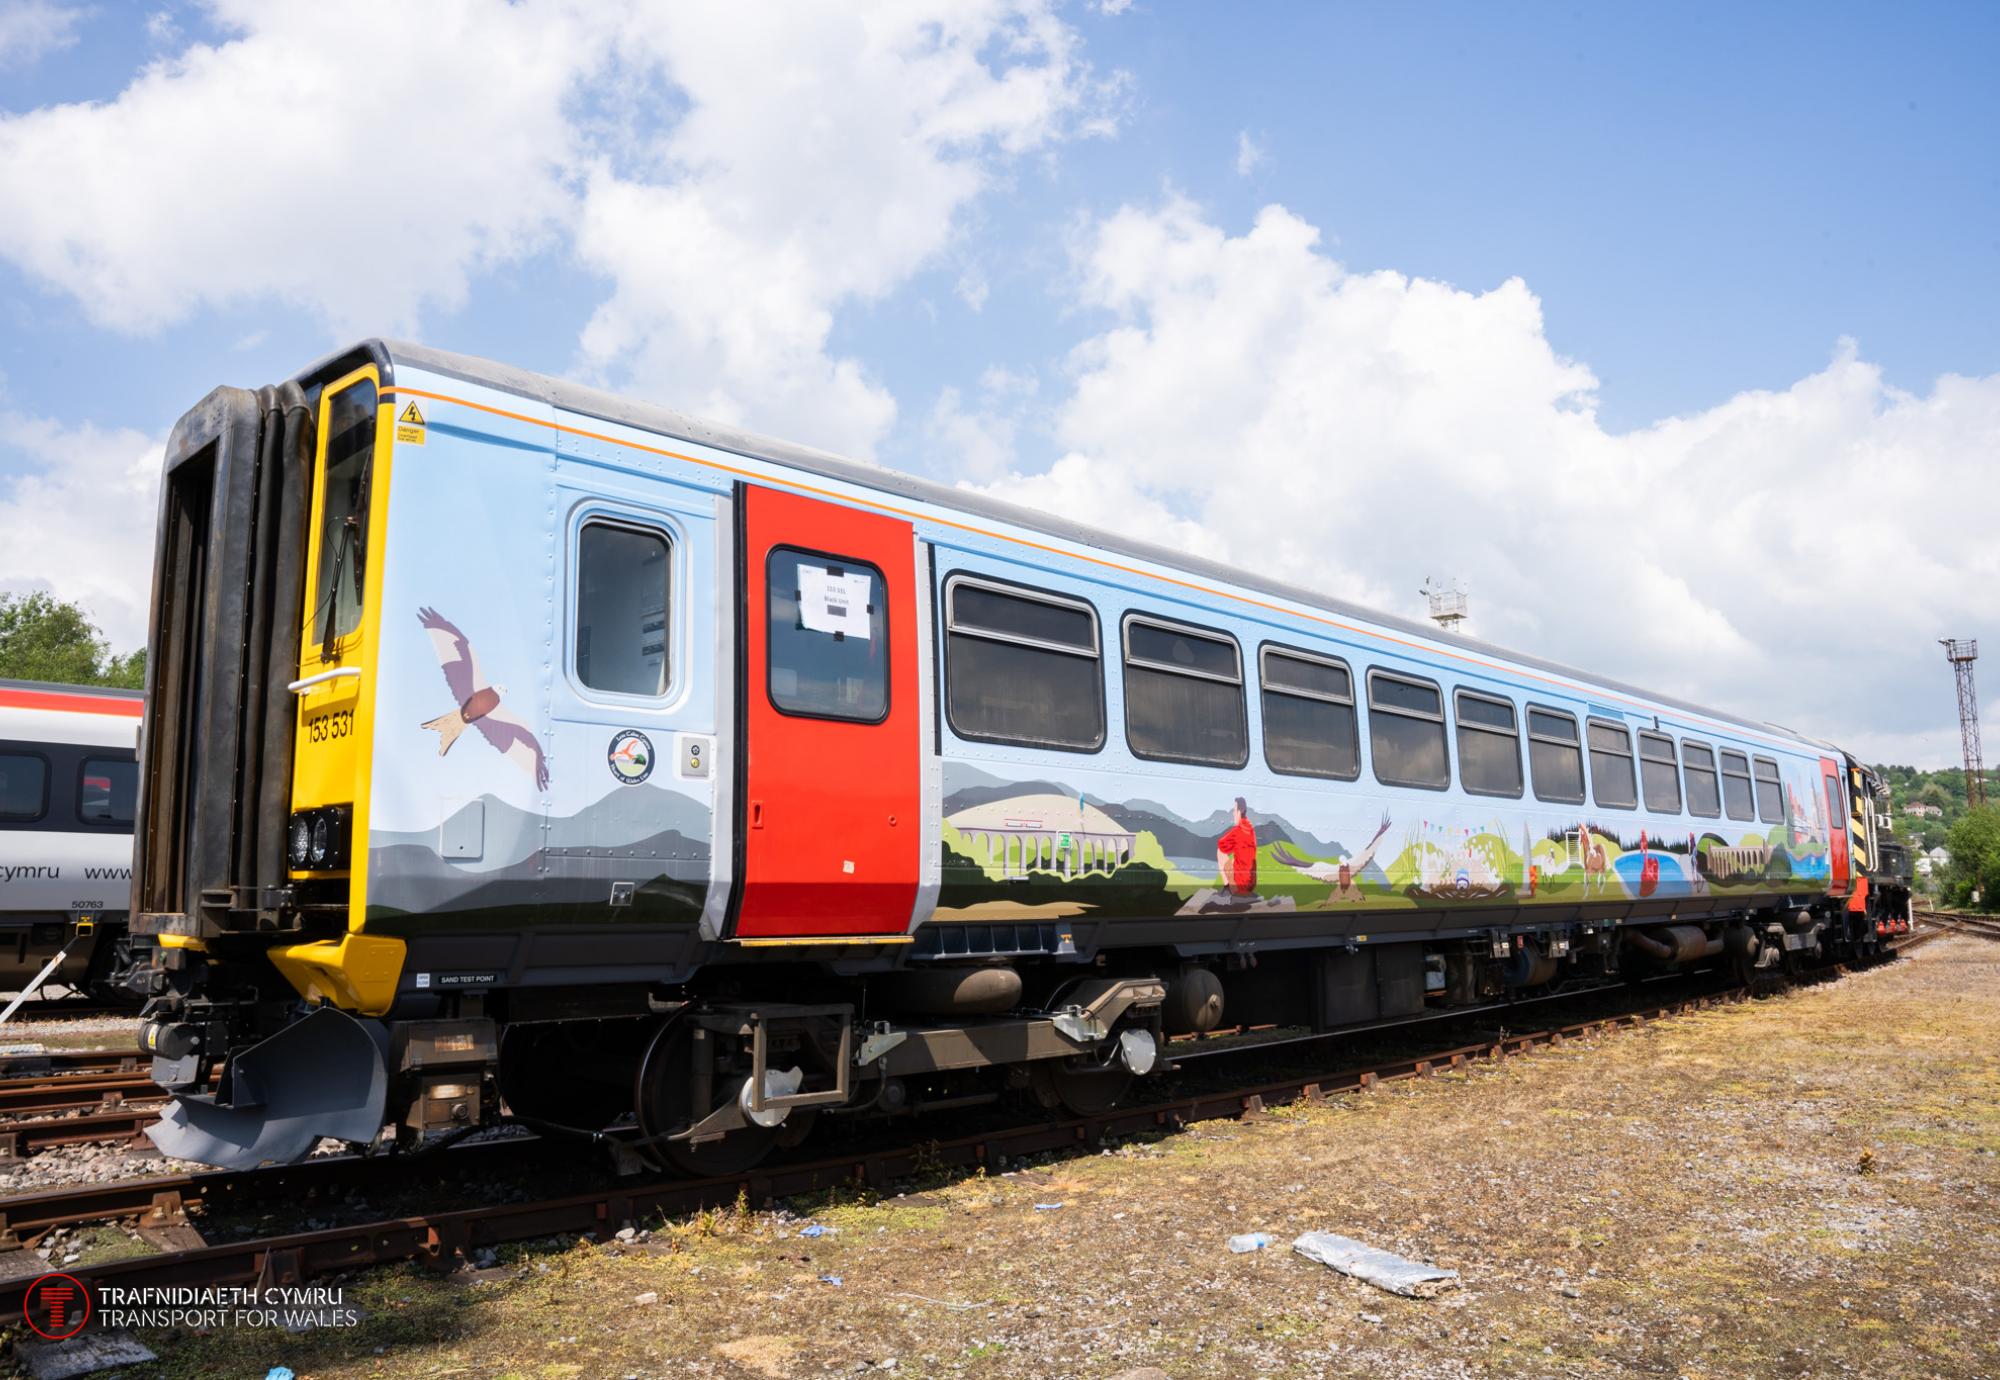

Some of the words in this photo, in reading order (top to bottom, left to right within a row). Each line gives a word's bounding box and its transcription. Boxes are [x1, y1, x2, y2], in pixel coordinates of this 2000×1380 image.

[308, 715, 329, 743] 153
[331, 709, 354, 739] 531
[71, 900, 104, 909] 50763
[460, 975, 475, 983] TEST
